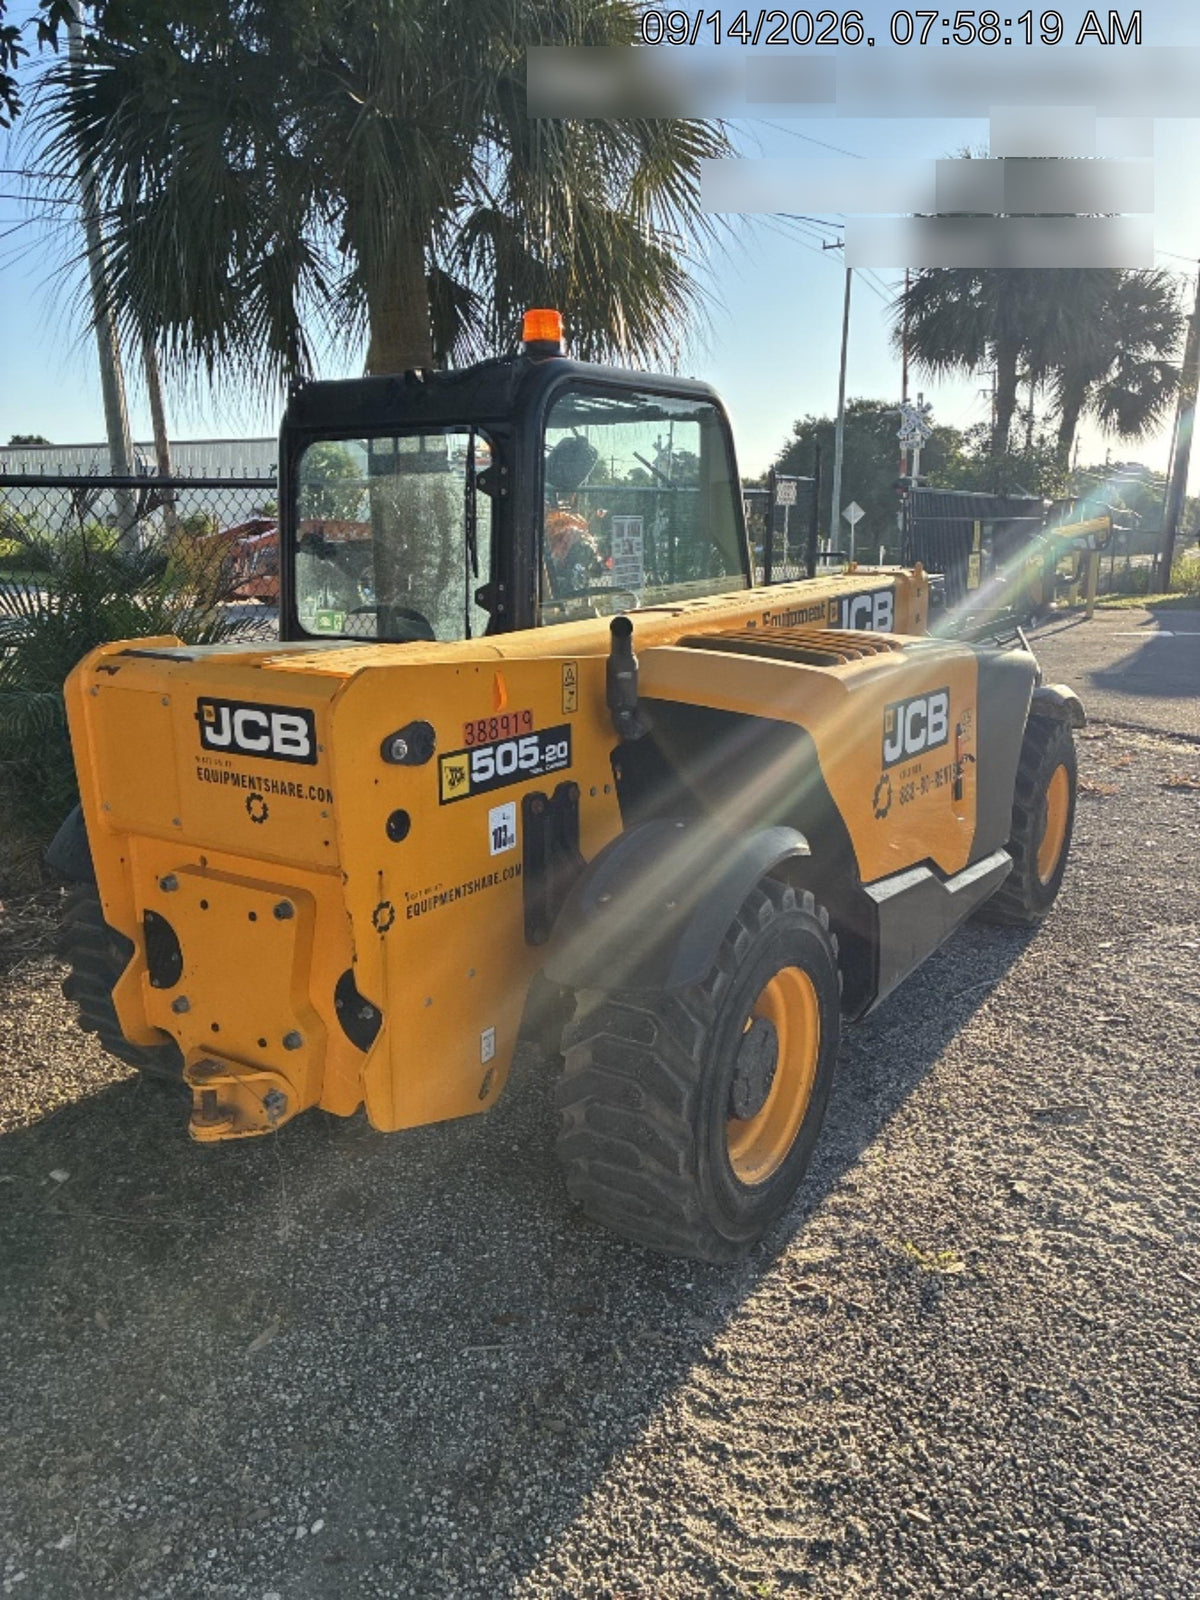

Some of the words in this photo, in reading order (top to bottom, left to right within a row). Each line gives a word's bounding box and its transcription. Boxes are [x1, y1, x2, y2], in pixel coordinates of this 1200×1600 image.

[763, 600, 826, 628] Equipment
[204, 706, 311, 757] JCB
[464, 710, 533, 746] 388919
[883, 692, 949, 763] JCB
